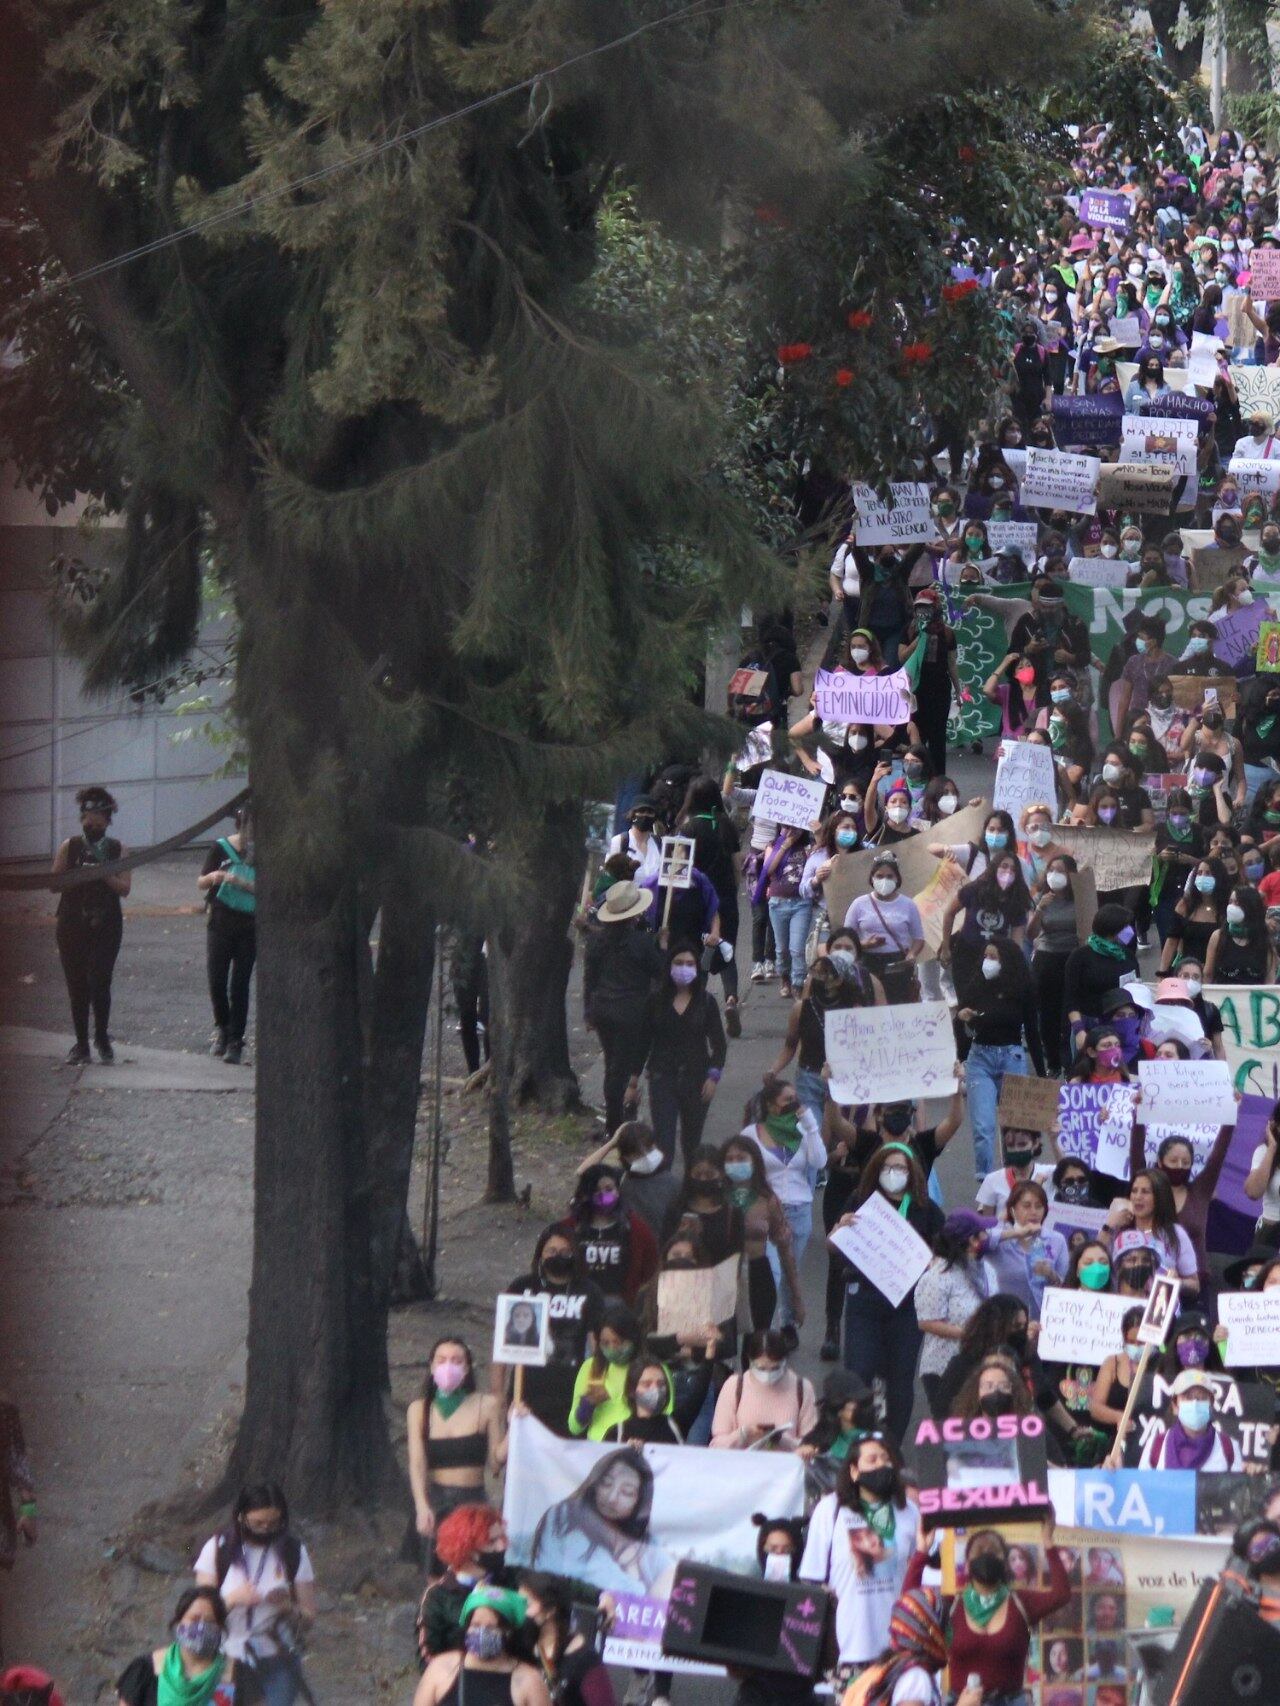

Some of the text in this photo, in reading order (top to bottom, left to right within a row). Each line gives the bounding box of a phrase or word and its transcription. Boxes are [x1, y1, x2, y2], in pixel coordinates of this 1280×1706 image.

[1087, 212, 1126, 226] VIOLENCIA
[1126, 428, 1194, 440] MALDITO
[1131, 451, 1187, 462] SISTEMA
[1242, 470, 1268, 485] grito
[856, 486, 870, 498] NO
[891, 521, 928, 538] SILENCIO
[816, 669, 907, 691] NO MAS
[814, 689, 909, 720] FEMINICIDIOS
[1059, 1084, 1111, 1111] SOMO
[1056, 1130, 1092, 1155] QUE
[1105, 1132, 1127, 1148] NO
[1071, 1335, 1088, 1346] no
[914, 1414, 1044, 1446] ACOSO
[918, 1479, 1050, 1515] SEXUAL
[1138, 1572, 1187, 1588] voz de
